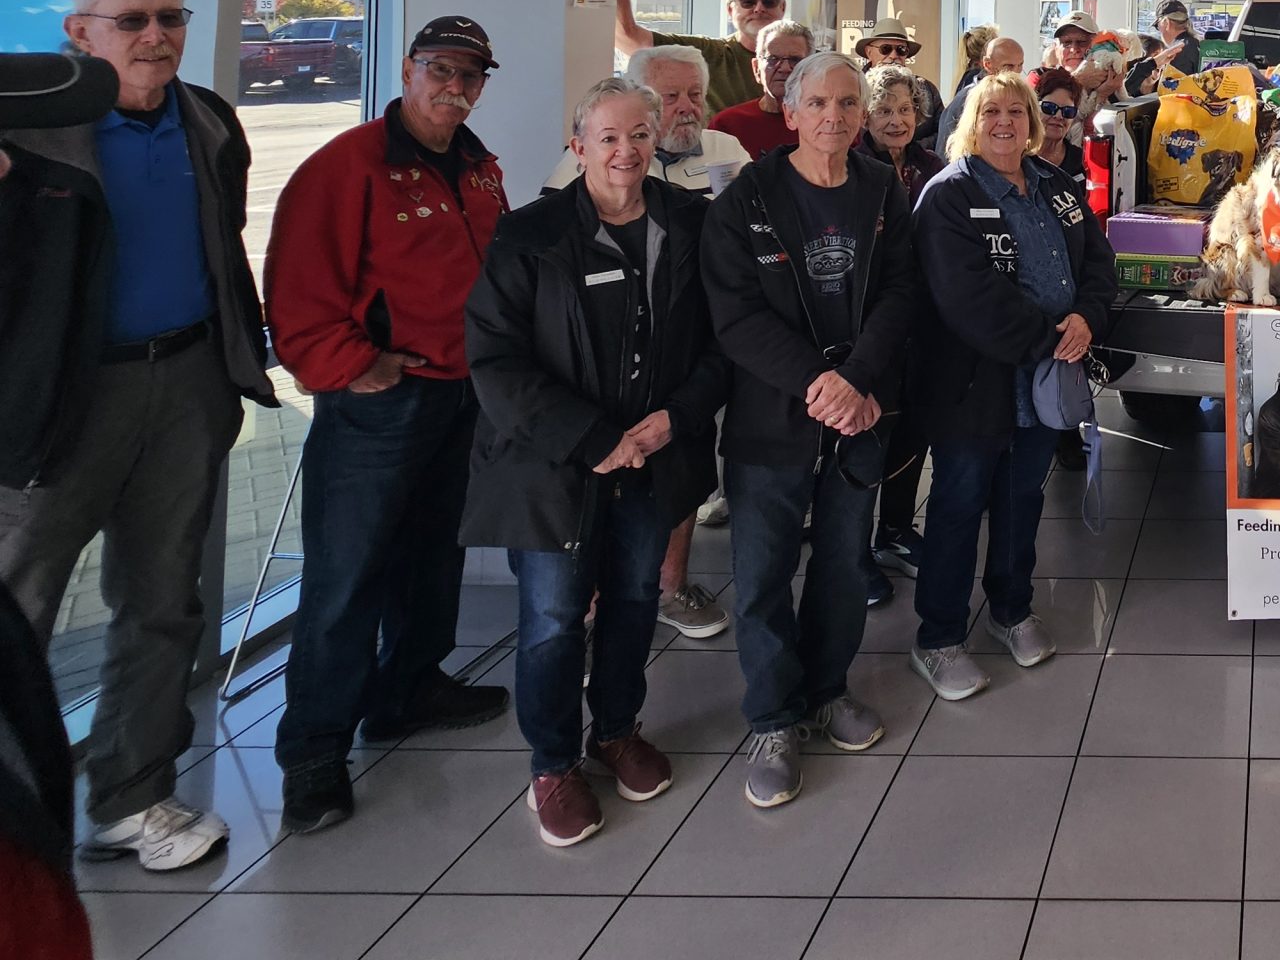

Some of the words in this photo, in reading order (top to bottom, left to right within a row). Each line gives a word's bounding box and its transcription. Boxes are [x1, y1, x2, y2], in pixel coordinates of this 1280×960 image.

[261, 0, 272, 9] 35
[841, 20, 874, 28] FEEDING
[1160, 134, 1207, 148] Pedigree
